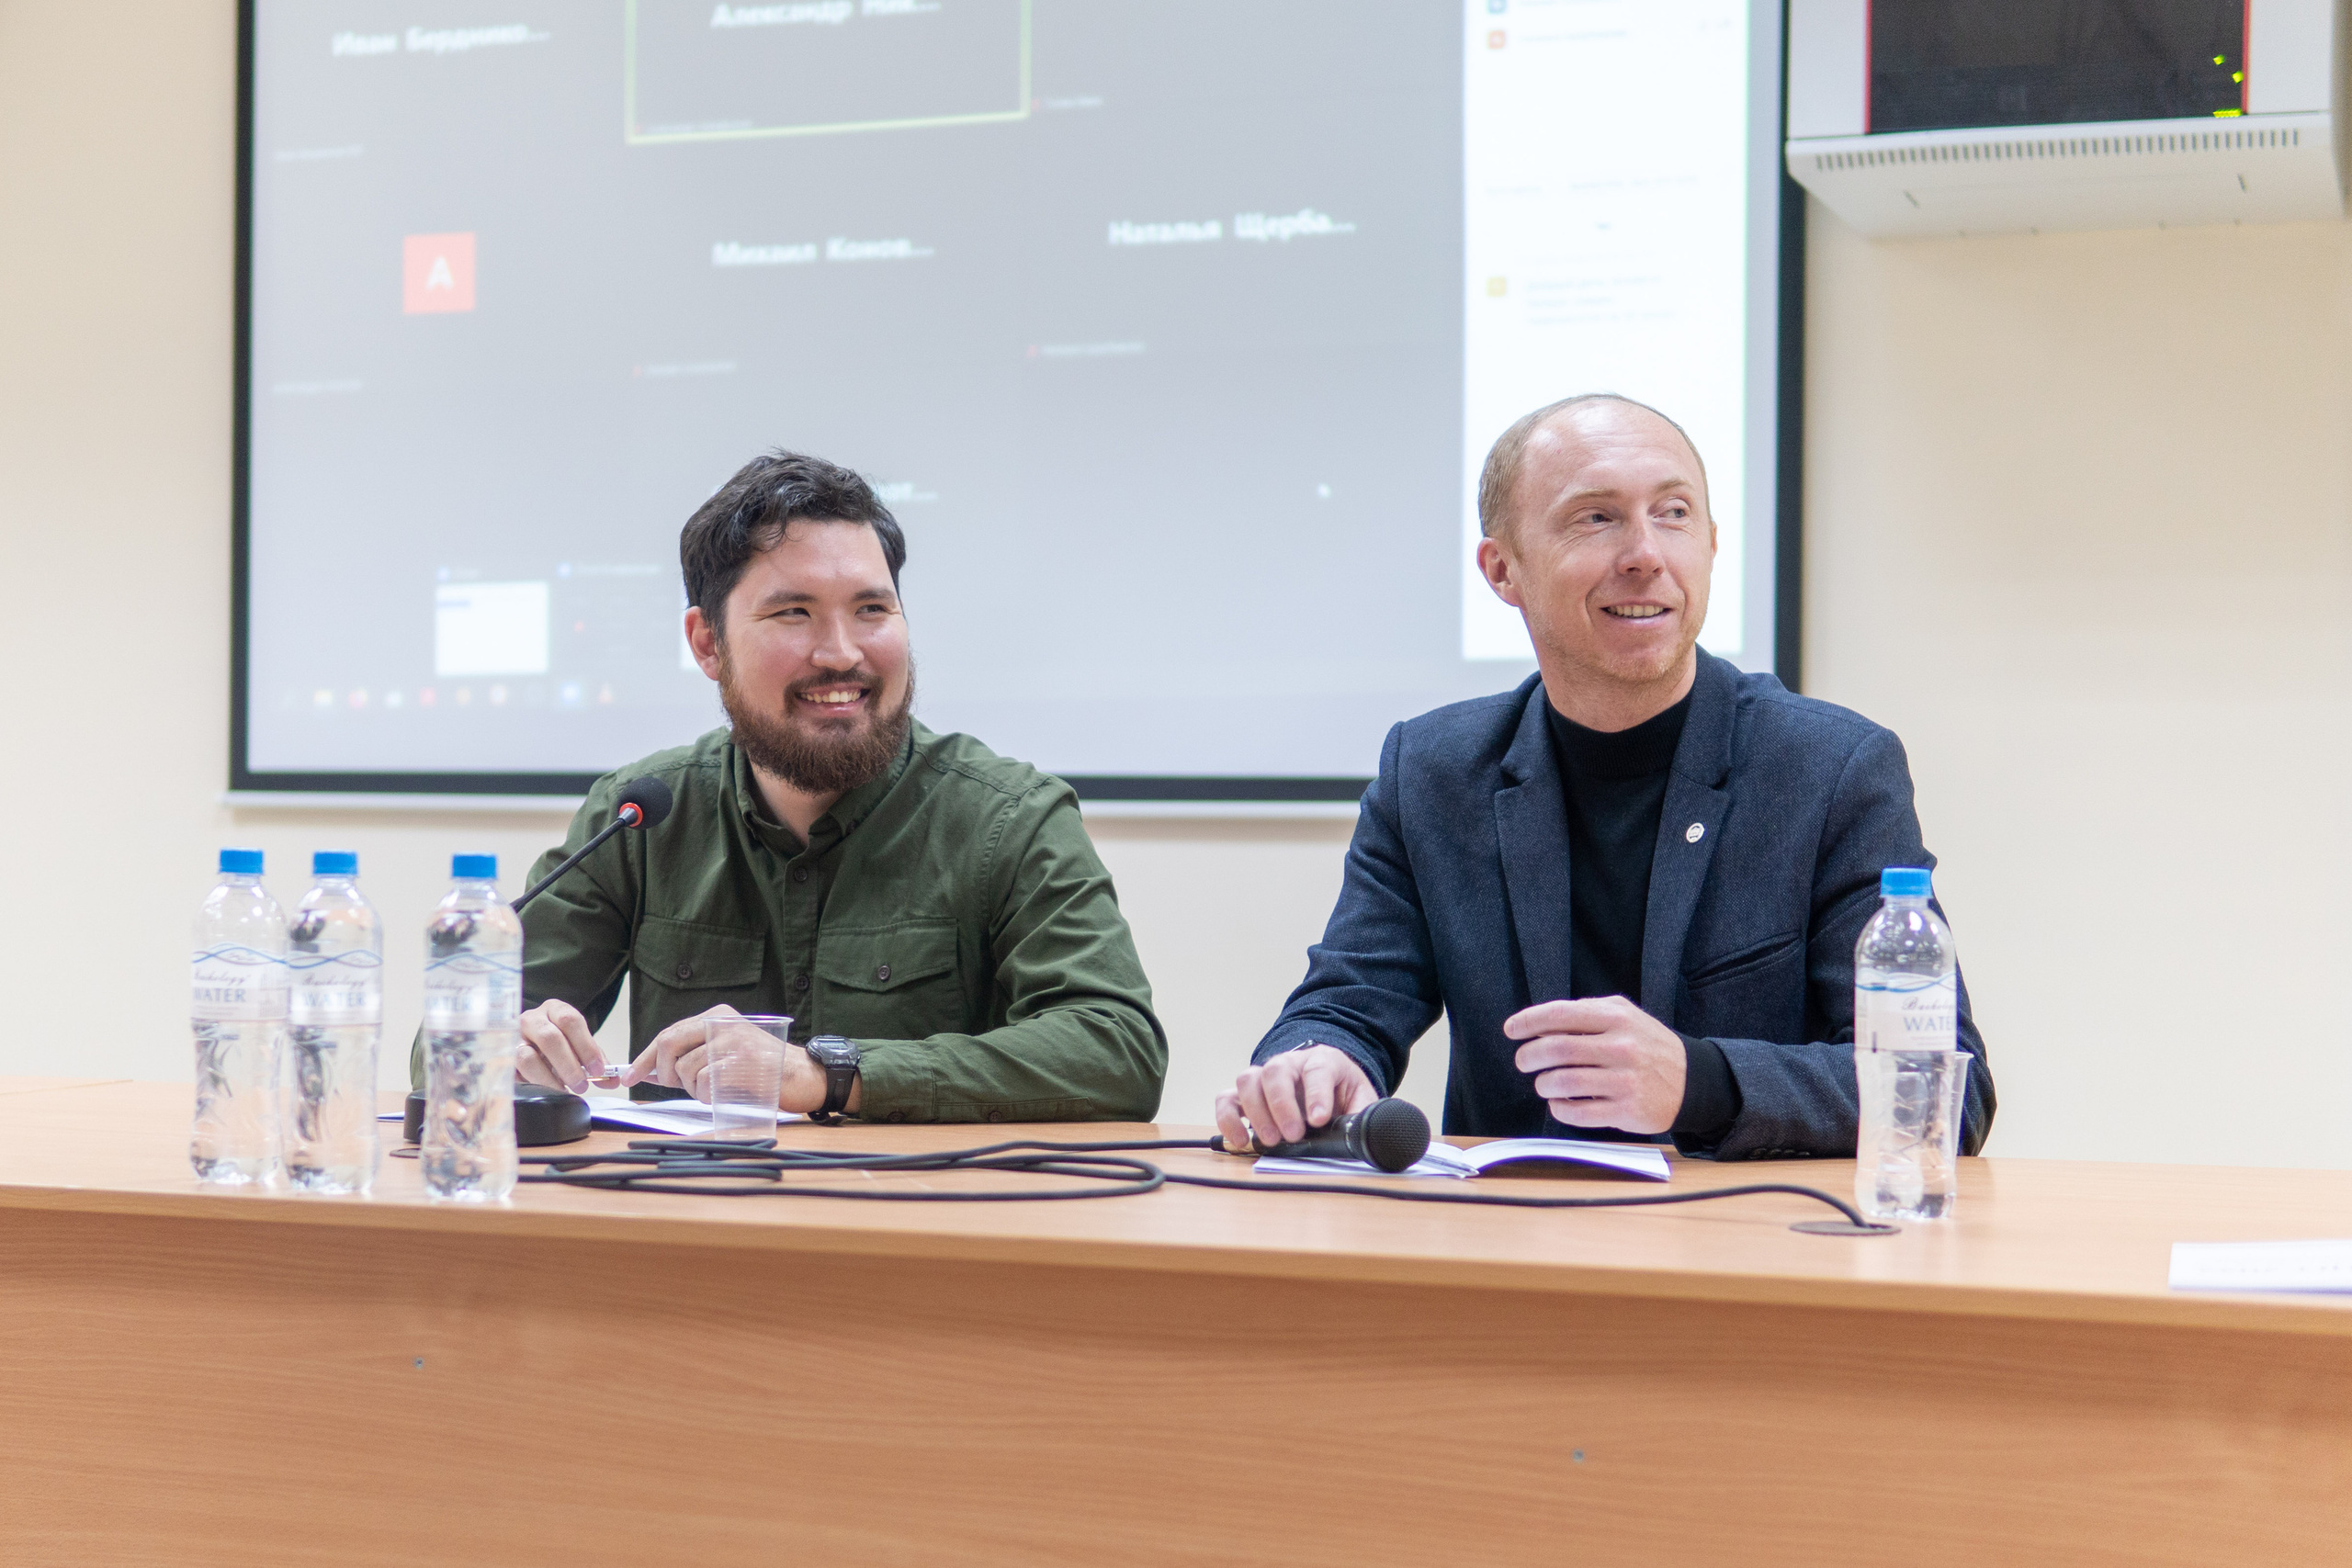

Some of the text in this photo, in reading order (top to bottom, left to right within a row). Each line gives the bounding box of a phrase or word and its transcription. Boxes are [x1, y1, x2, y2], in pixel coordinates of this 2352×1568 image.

[710, 2, 854, 27] Александр
[332, 32, 397, 56] Иван
[1108, 220, 1222, 244] Наталья
[712, 243, 817, 265] Михаил
[1903, 1016, 1954, 1031] WATE
